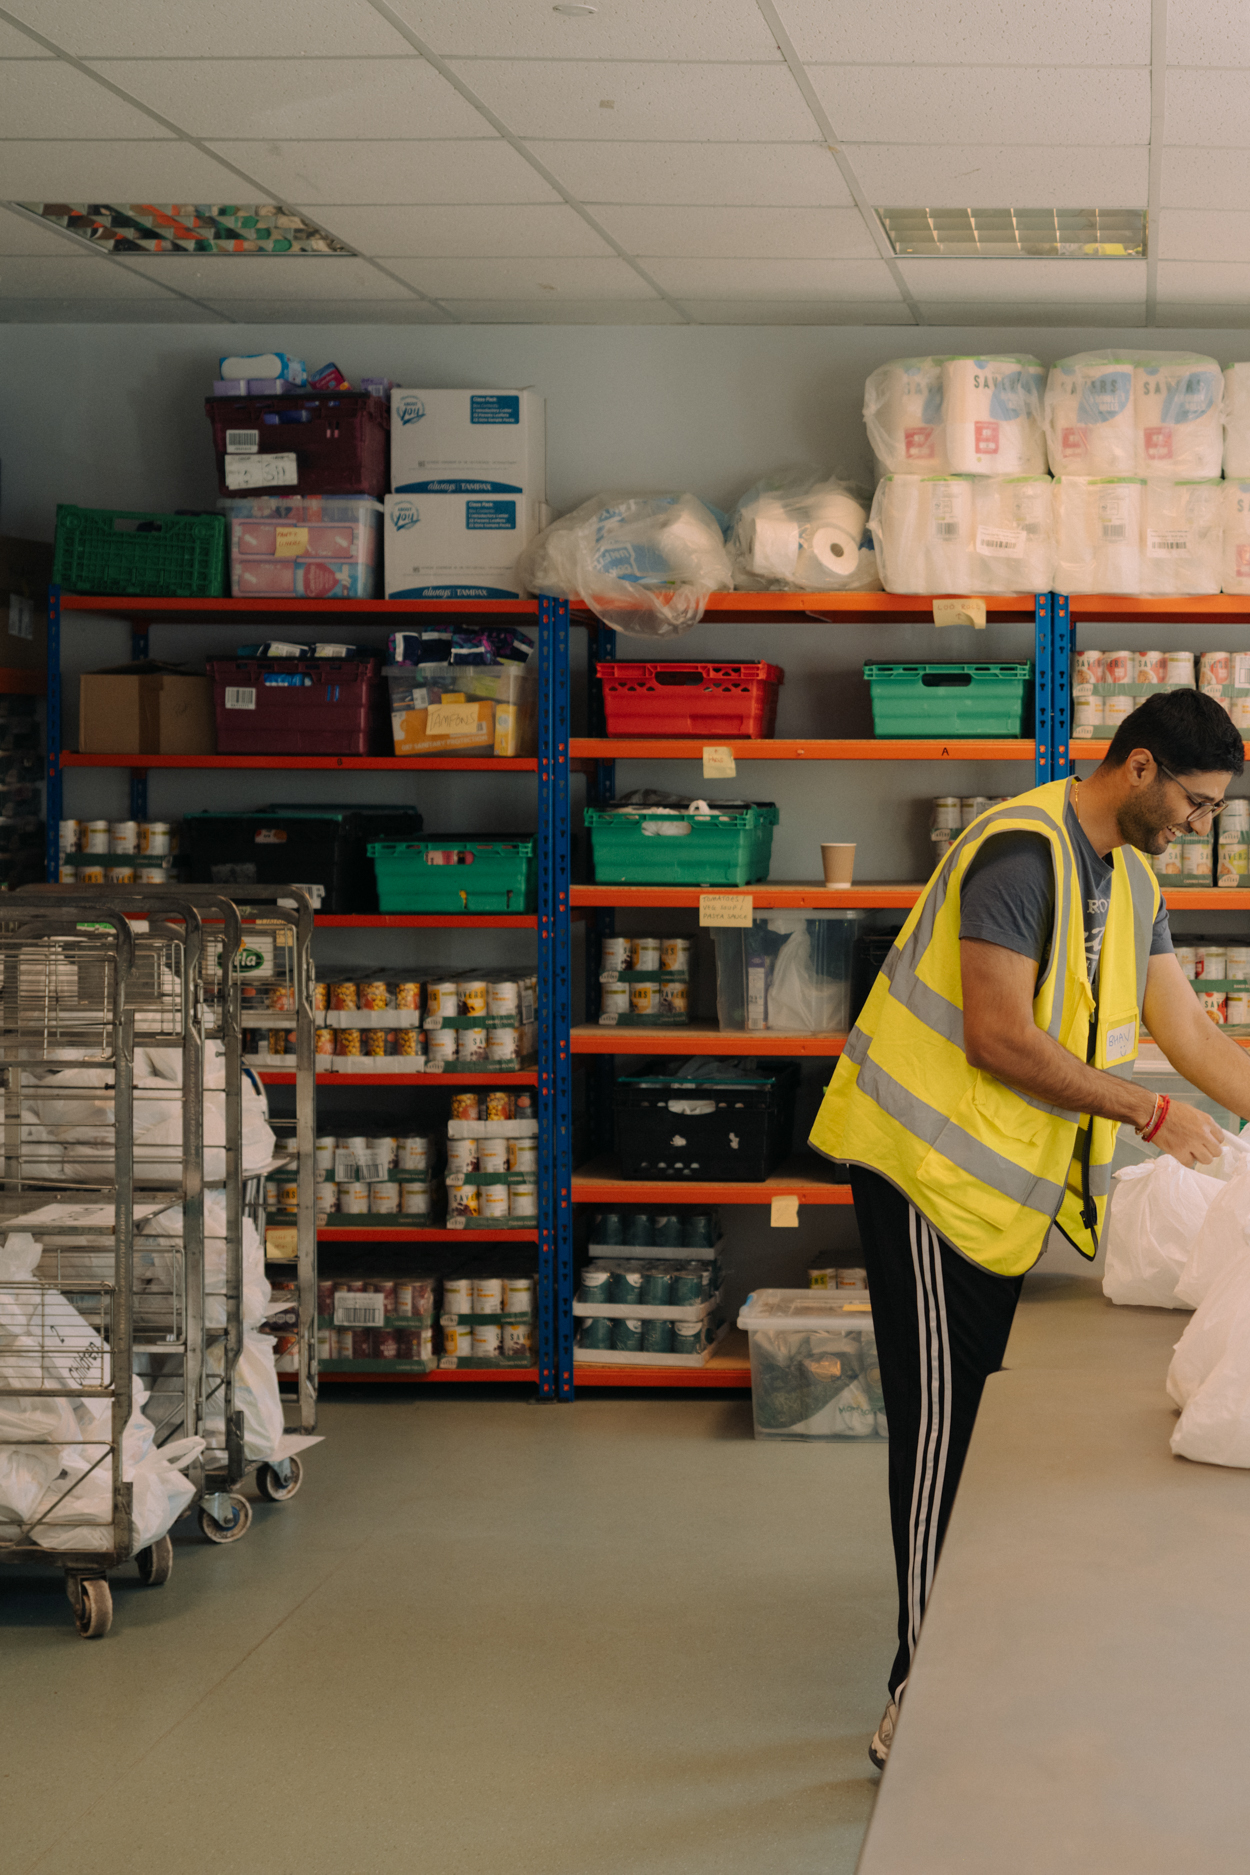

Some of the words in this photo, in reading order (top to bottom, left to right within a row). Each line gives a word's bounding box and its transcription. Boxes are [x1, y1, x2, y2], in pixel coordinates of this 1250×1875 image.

[427, 480, 456, 493] always
[461, 483, 493, 491] TAMPAX
[422, 586, 452, 599] always
[456, 588, 488, 596] TAMPAX
[413, 738, 447, 750] SANITARY
[447, 734, 489, 747] PROTECTION
[1109, 1031, 1130, 1047] BHAV
